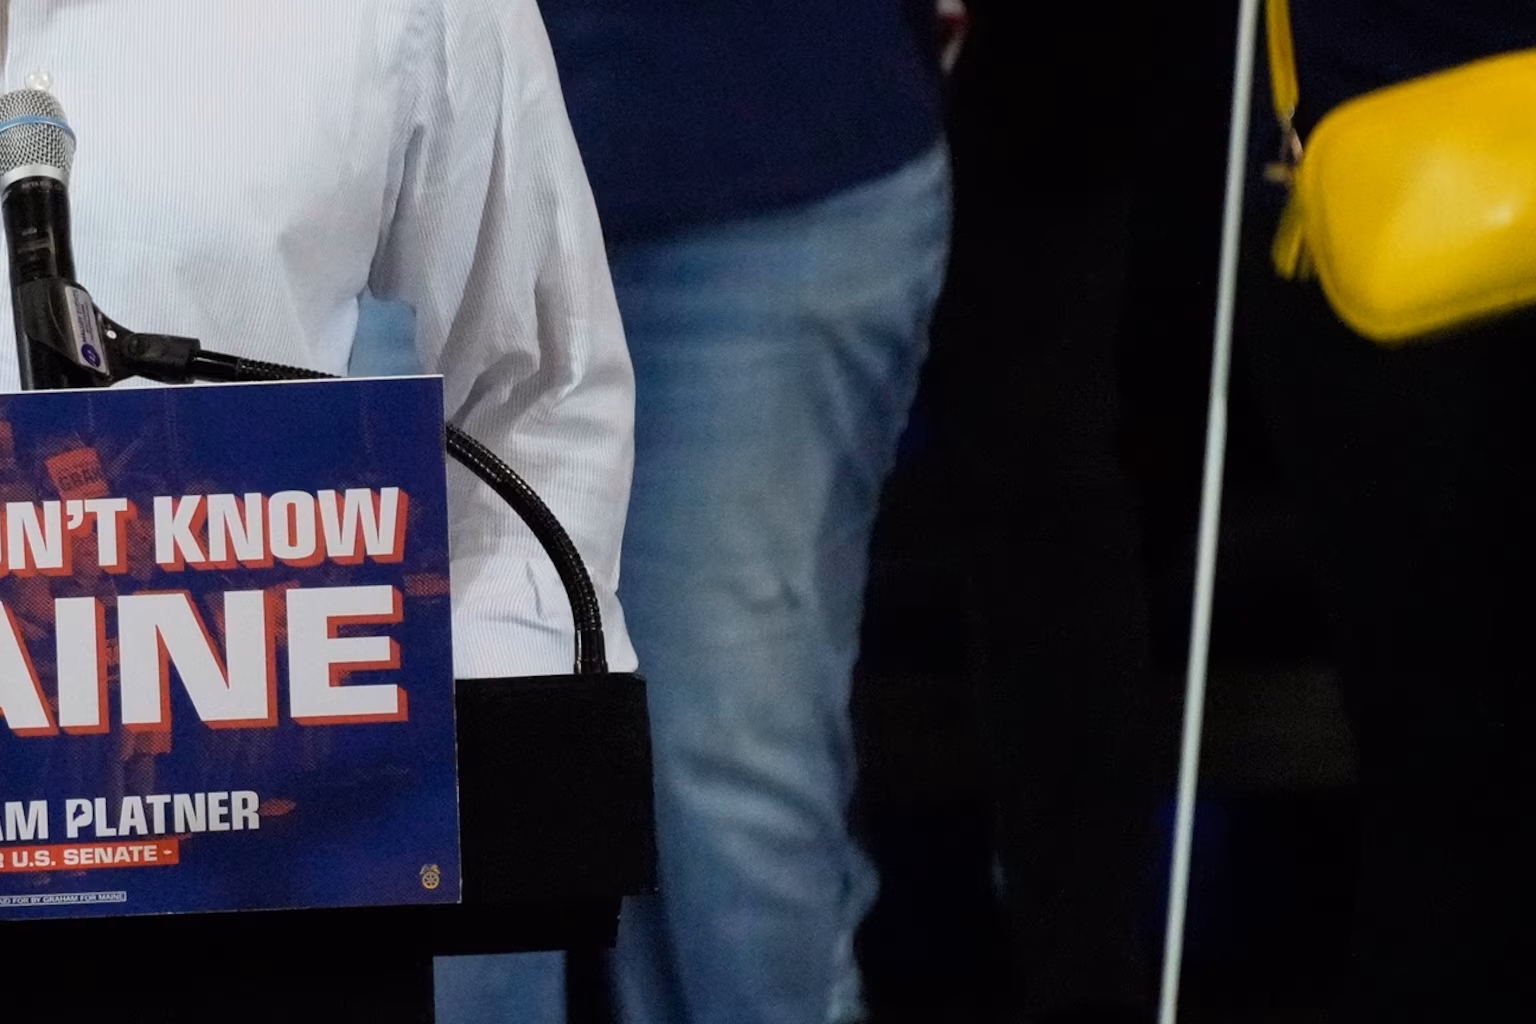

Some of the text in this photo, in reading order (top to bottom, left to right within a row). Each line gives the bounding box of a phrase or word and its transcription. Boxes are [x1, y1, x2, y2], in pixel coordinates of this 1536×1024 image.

[154, 486, 400, 564] KNOW
[65, 790, 261, 838] PLATNER
[12, 849, 57, 868] U.S.
[64, 845, 158, 865] SENATE
[13, 897, 30, 905] FOR
[31, 896, 41, 904] BY
[43, 896, 78, 904] GRAHAM
[98, 893, 124, 901] MAINE
